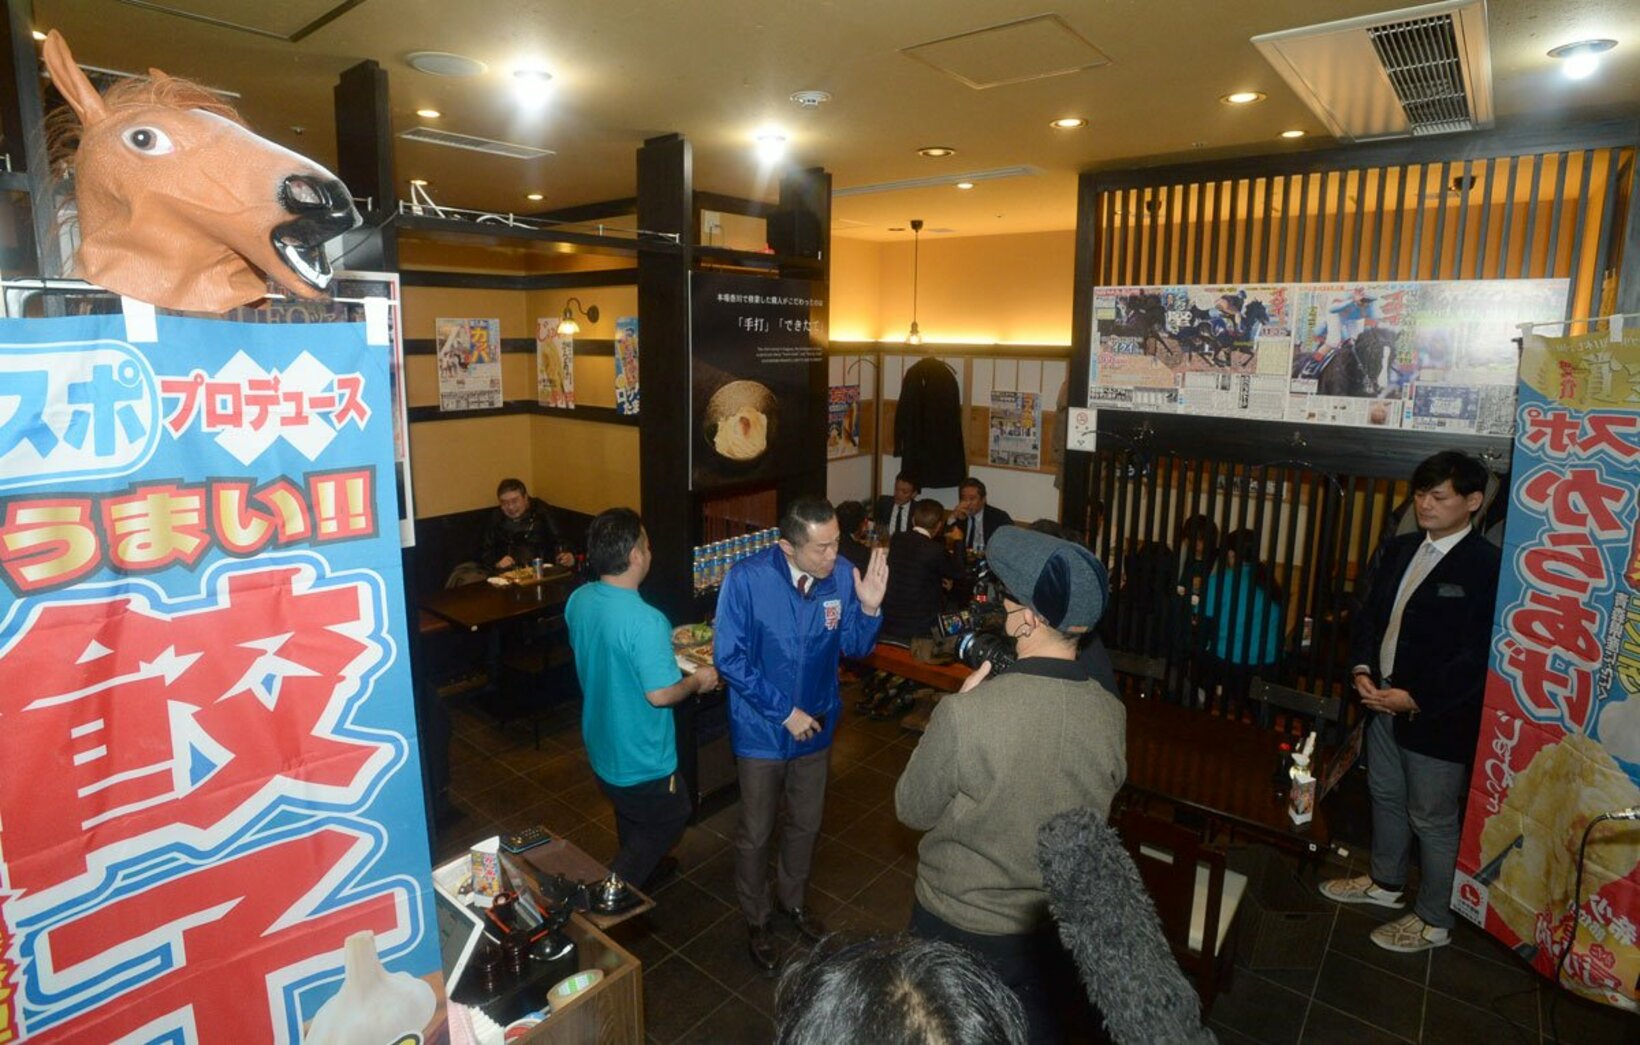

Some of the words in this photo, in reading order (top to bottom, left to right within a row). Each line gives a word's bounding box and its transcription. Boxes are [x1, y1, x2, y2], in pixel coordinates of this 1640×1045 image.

[0, 361, 148, 459] スポ
[161, 372, 368, 431] プロデュース
